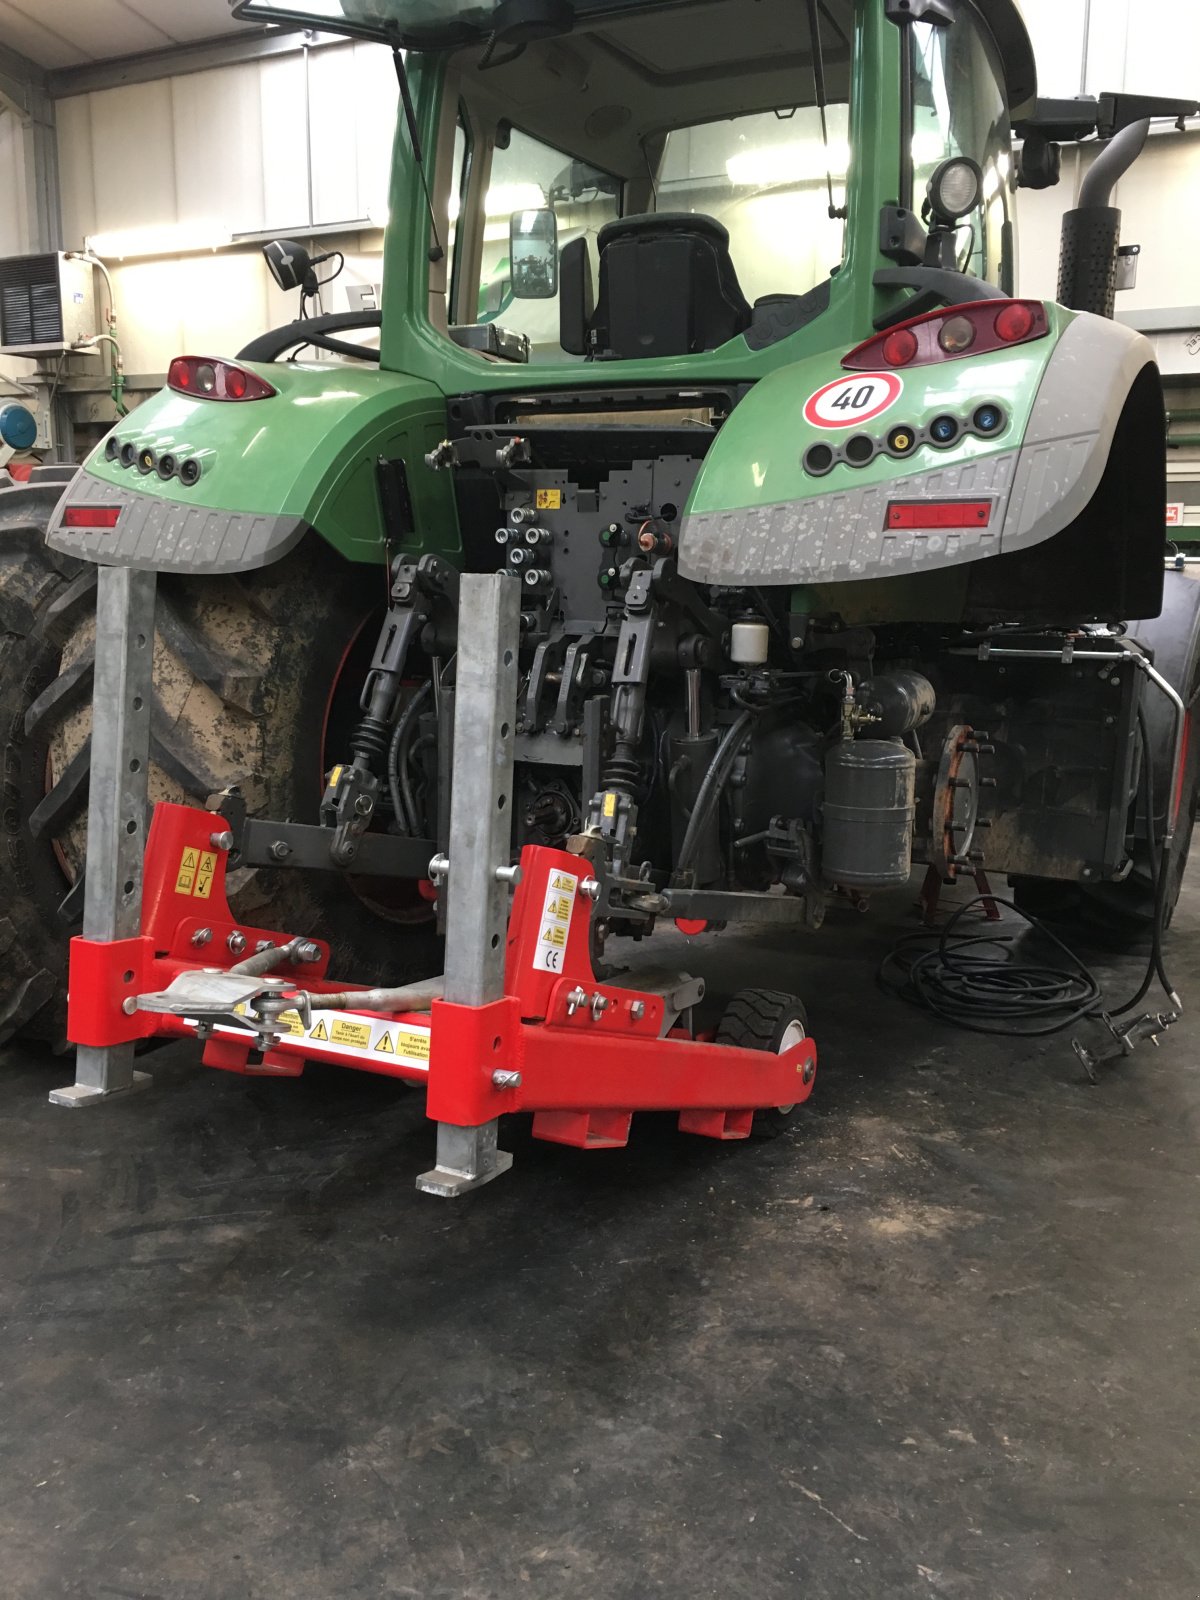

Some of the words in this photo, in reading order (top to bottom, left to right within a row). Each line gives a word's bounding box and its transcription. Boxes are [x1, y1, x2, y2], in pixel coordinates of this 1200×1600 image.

[831, 385, 875, 410] 40
[546, 950, 559, 969] CE
[341, 1022, 362, 1033] Danger
